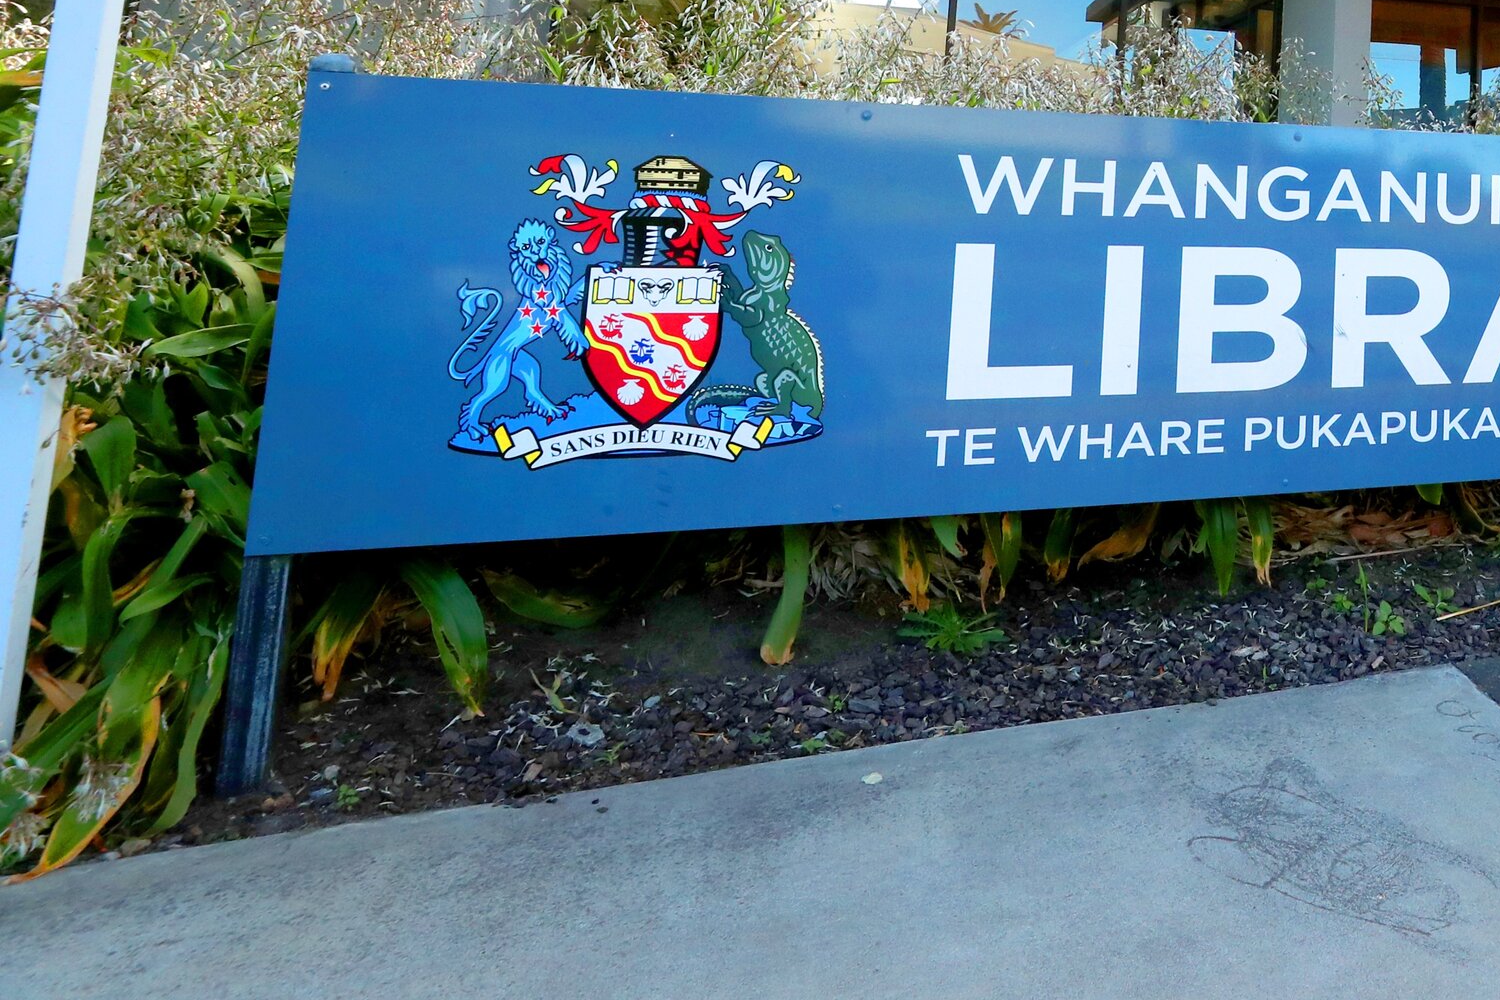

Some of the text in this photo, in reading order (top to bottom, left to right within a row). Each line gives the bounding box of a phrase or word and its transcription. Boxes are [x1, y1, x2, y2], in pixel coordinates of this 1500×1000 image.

[550, 429, 721, 457] SANS DIEU RIEN
[926, 428, 997, 467] TE
[1017, 417, 1226, 463] WHARE
